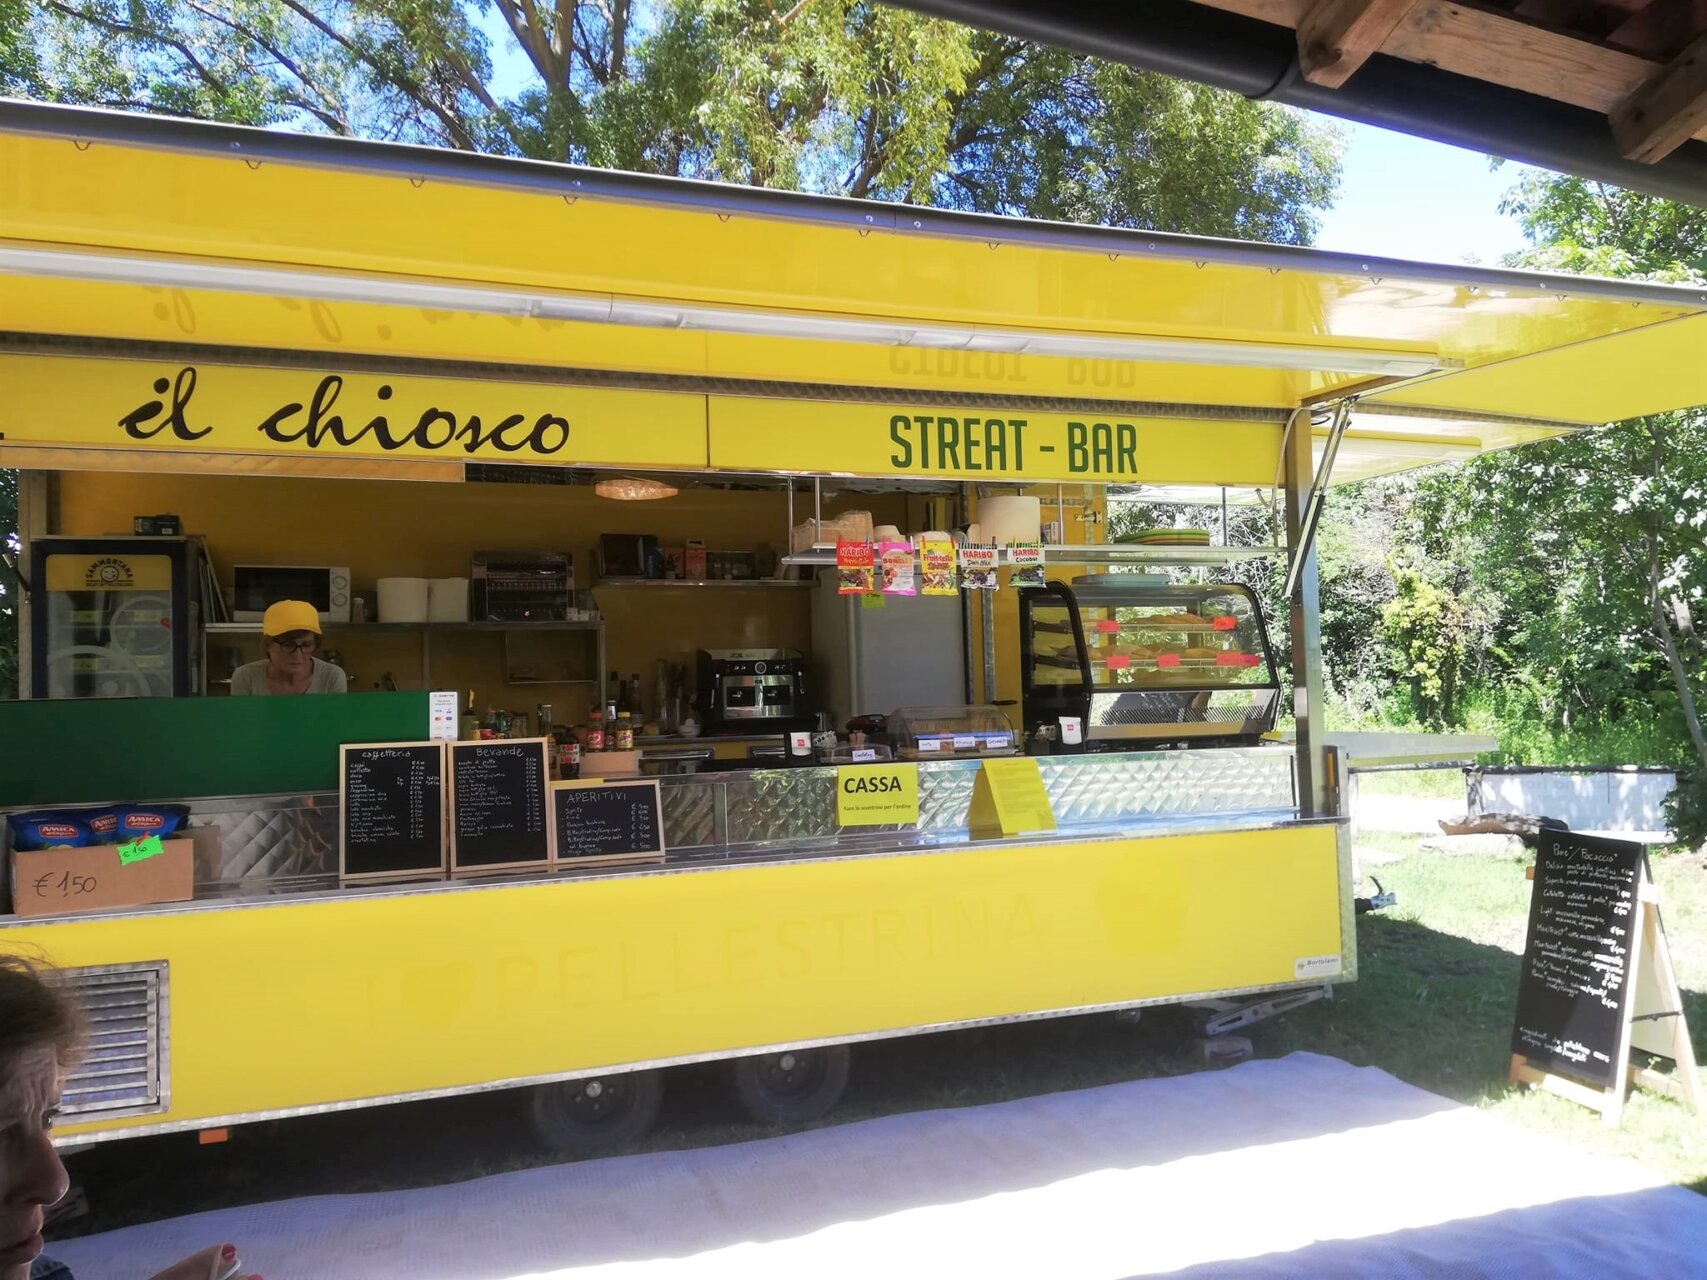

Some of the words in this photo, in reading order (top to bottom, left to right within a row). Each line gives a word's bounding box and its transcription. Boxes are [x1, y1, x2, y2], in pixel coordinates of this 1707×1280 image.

[118, 367, 213, 441] il
[258, 375, 570, 454] chiosco
[889, 415, 1028, 472] STREAT
[1067, 421, 1138, 475] BAR
[841, 548, 870, 556] HARIBO
[963, 551, 993, 560] HARIBO
[1012, 549, 1039, 557] HARIBO
[85, 557, 134, 579] SAMMONTANA
[475, 746, 524, 757] Bevande
[844, 776, 902, 794] CASSA
[566, 791, 626, 803] APERITIVI
[33, 872, 54, 897] €
[56, 870, 97, 897] 1,50
[496, 892, 1041, 1022] PELLESTRINA
